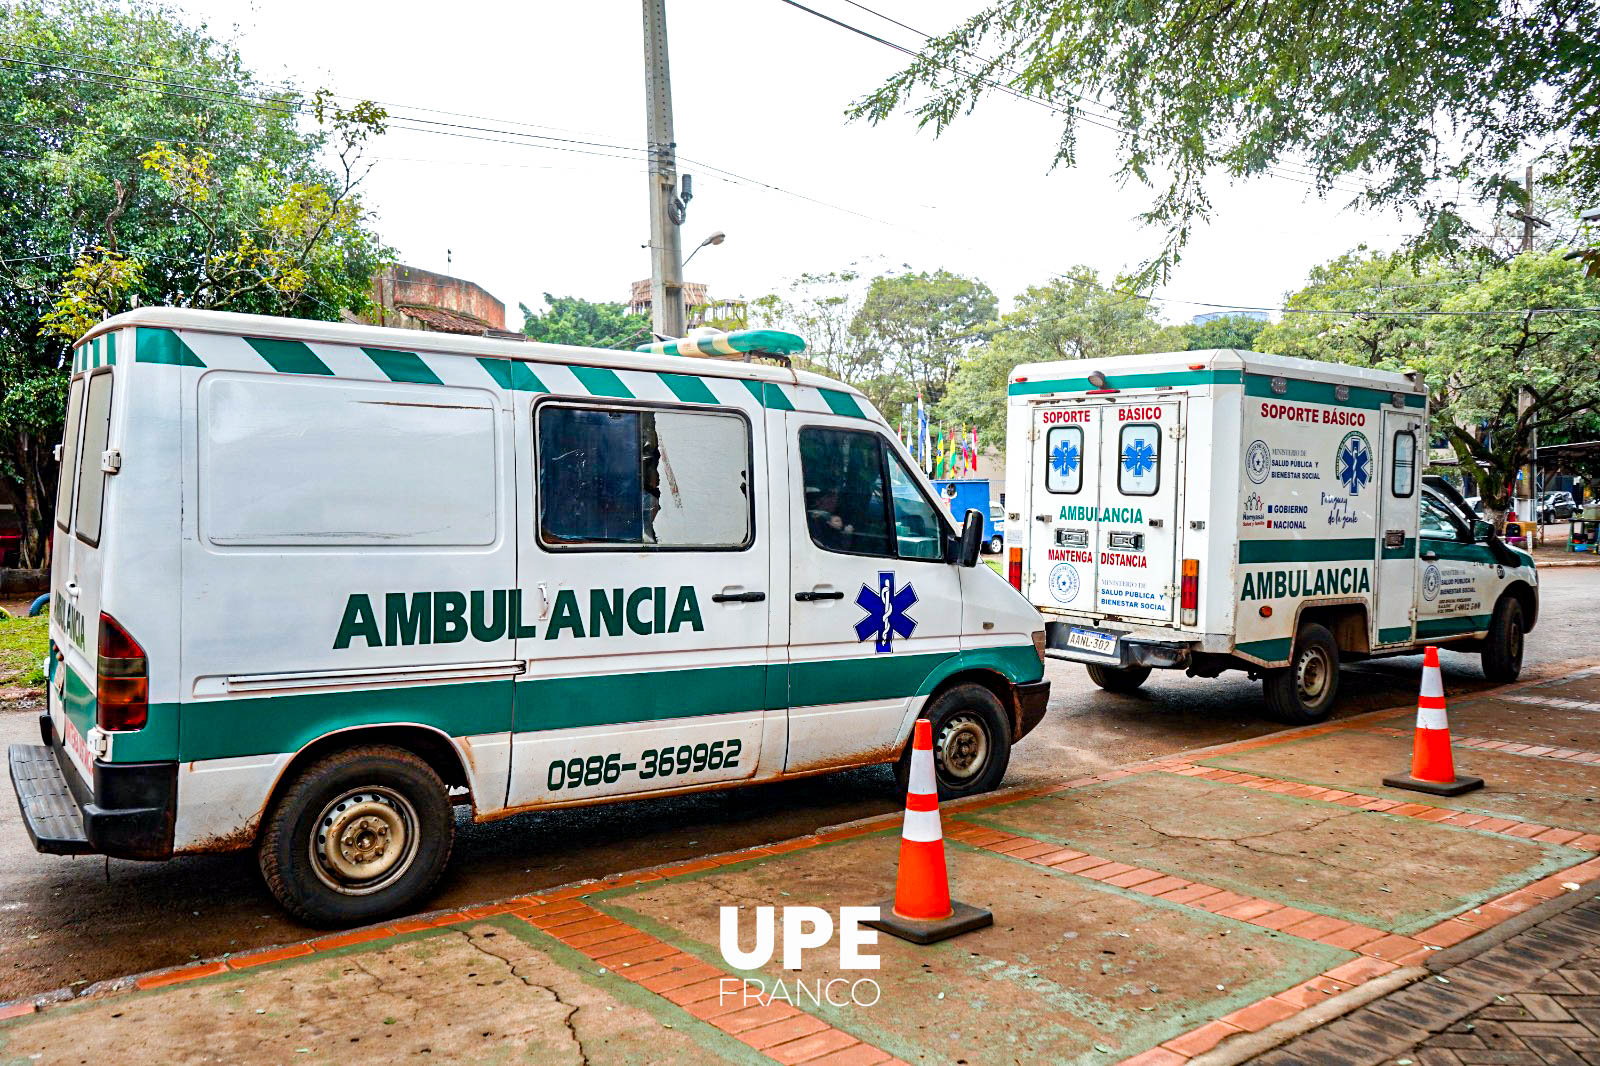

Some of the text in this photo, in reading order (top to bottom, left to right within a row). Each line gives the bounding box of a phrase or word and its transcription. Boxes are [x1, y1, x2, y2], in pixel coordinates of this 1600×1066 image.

[1043, 410, 1091, 424] SOPORTE
[1118, 406, 1162, 421] BÁSICO
[1260, 402, 1365, 426] SOPORTE BÁSICO
[1059, 505, 1144, 524] AMBULANCIA
[1274, 505, 1308, 513] GOBIERNO
[1273, 521, 1306, 529] NACIONAL
[1048, 549, 1147, 568] MANTENGA DISTANCIA
[1240, 568, 1370, 601] AMBULANCIA
[1101, 598, 1166, 611] BIENESTAR SOCIAL
[333, 585, 704, 649] AMBULANCIA
[547, 738, 742, 791] 0986-369962
